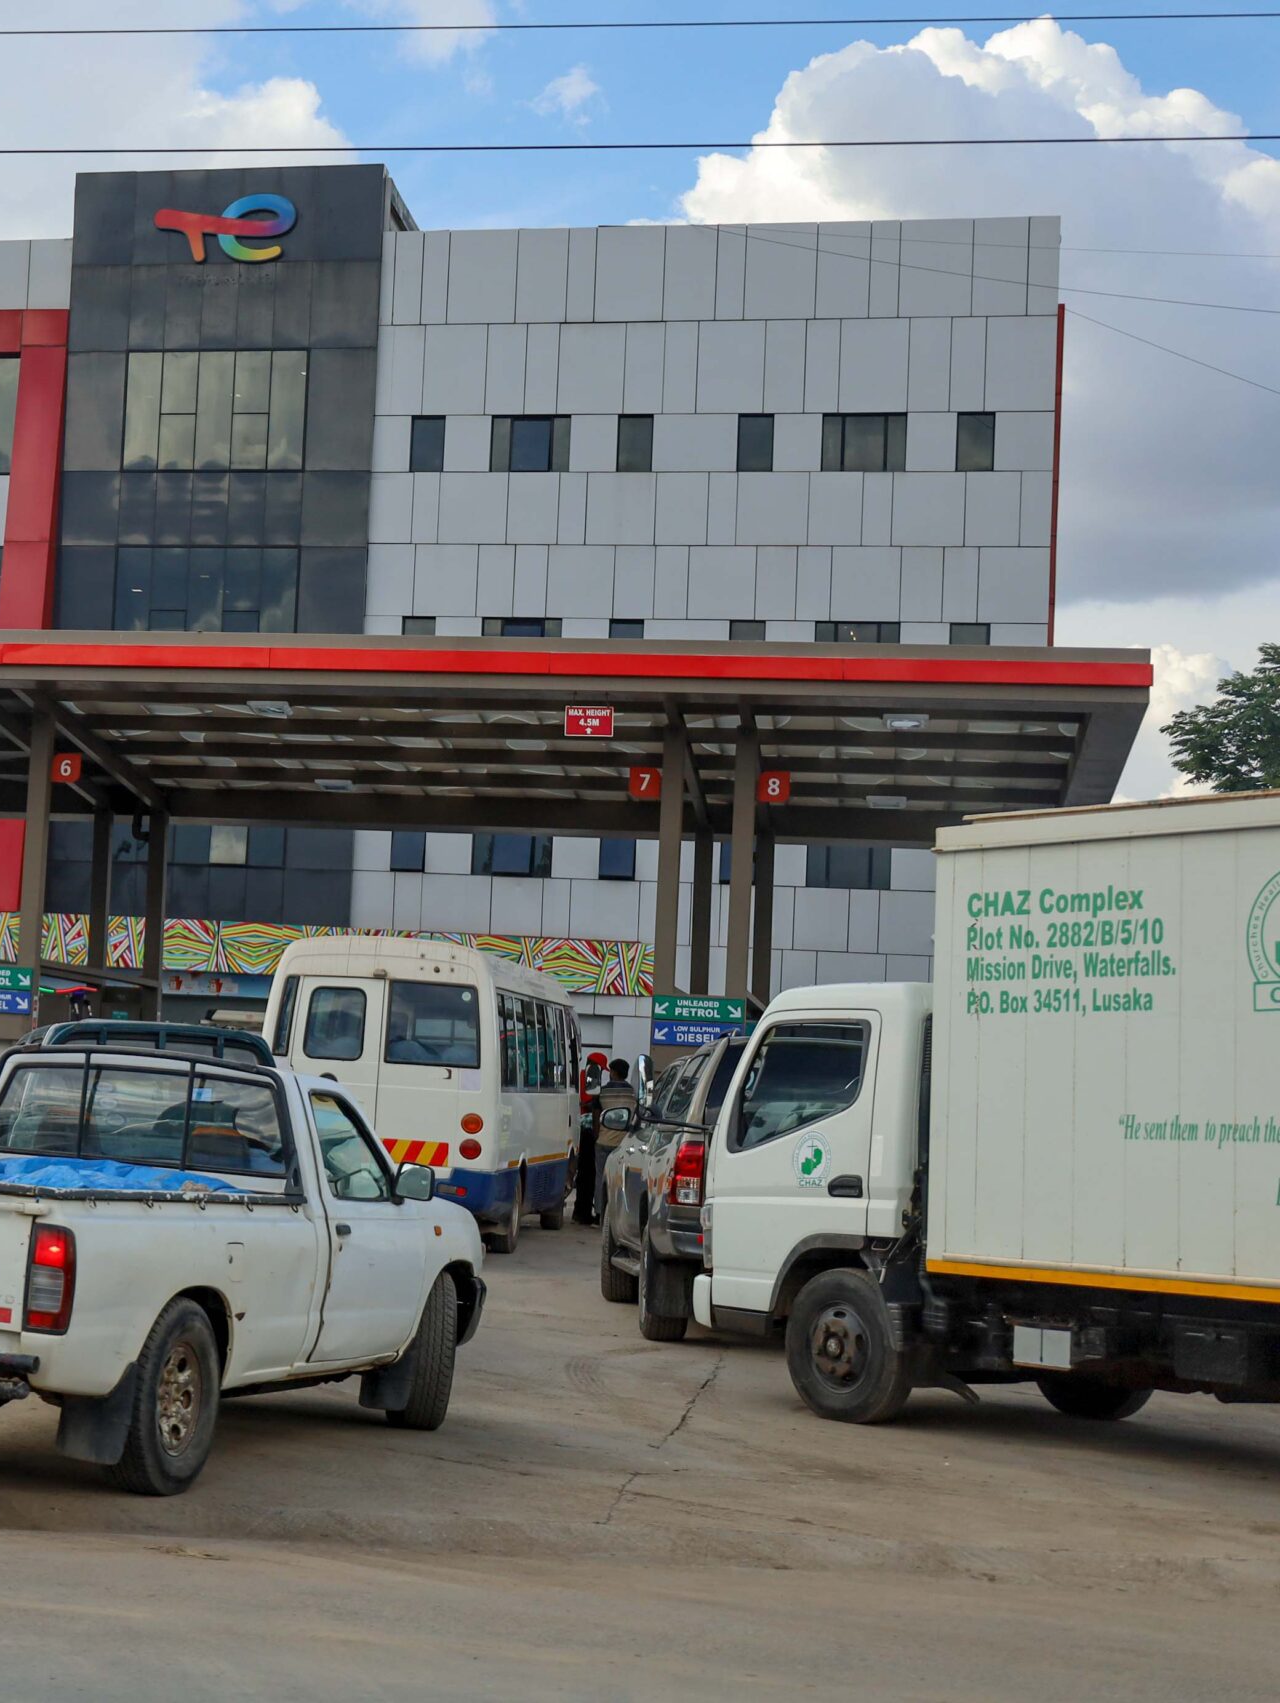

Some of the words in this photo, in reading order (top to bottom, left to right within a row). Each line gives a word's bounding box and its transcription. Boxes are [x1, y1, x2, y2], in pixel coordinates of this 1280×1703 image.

[586, 709, 611, 717] HEIGHT
[578, 718, 600, 727] 4.5M
[60, 760, 72, 777] 6
[639, 773, 651, 791] 7
[767, 778, 780, 796] 8
[967, 889, 1032, 918] CHAZ
[1039, 884, 1144, 918] Complex
[966, 925, 1003, 951] Plot
[1009, 924, 1040, 950] No.
[1046, 917, 1165, 948] 2882/B/5/10
[1250, 915, 1268, 979] Churches
[966, 955, 1026, 982] Mission
[1031, 953, 1078, 984] Drive,
[1083, 949, 1177, 978] Waterfalls.
[677, 999, 720, 1008] UNLEADED
[999, 990, 1028, 1014] Box
[1033, 987, 1087, 1017] 34511,
[1092, 987, 1154, 1012] Lusaka
[674, 1007, 721, 1018] PETROL
[676, 1034, 715, 1043] DIESEL
[1143, 1119, 1168, 1141] sent
[1169, 1114, 1199, 1142] them
[1204, 1119, 1217, 1142] to
[1217, 1115, 1261, 1150] preach
[798, 1179, 823, 1187] CHAZ
